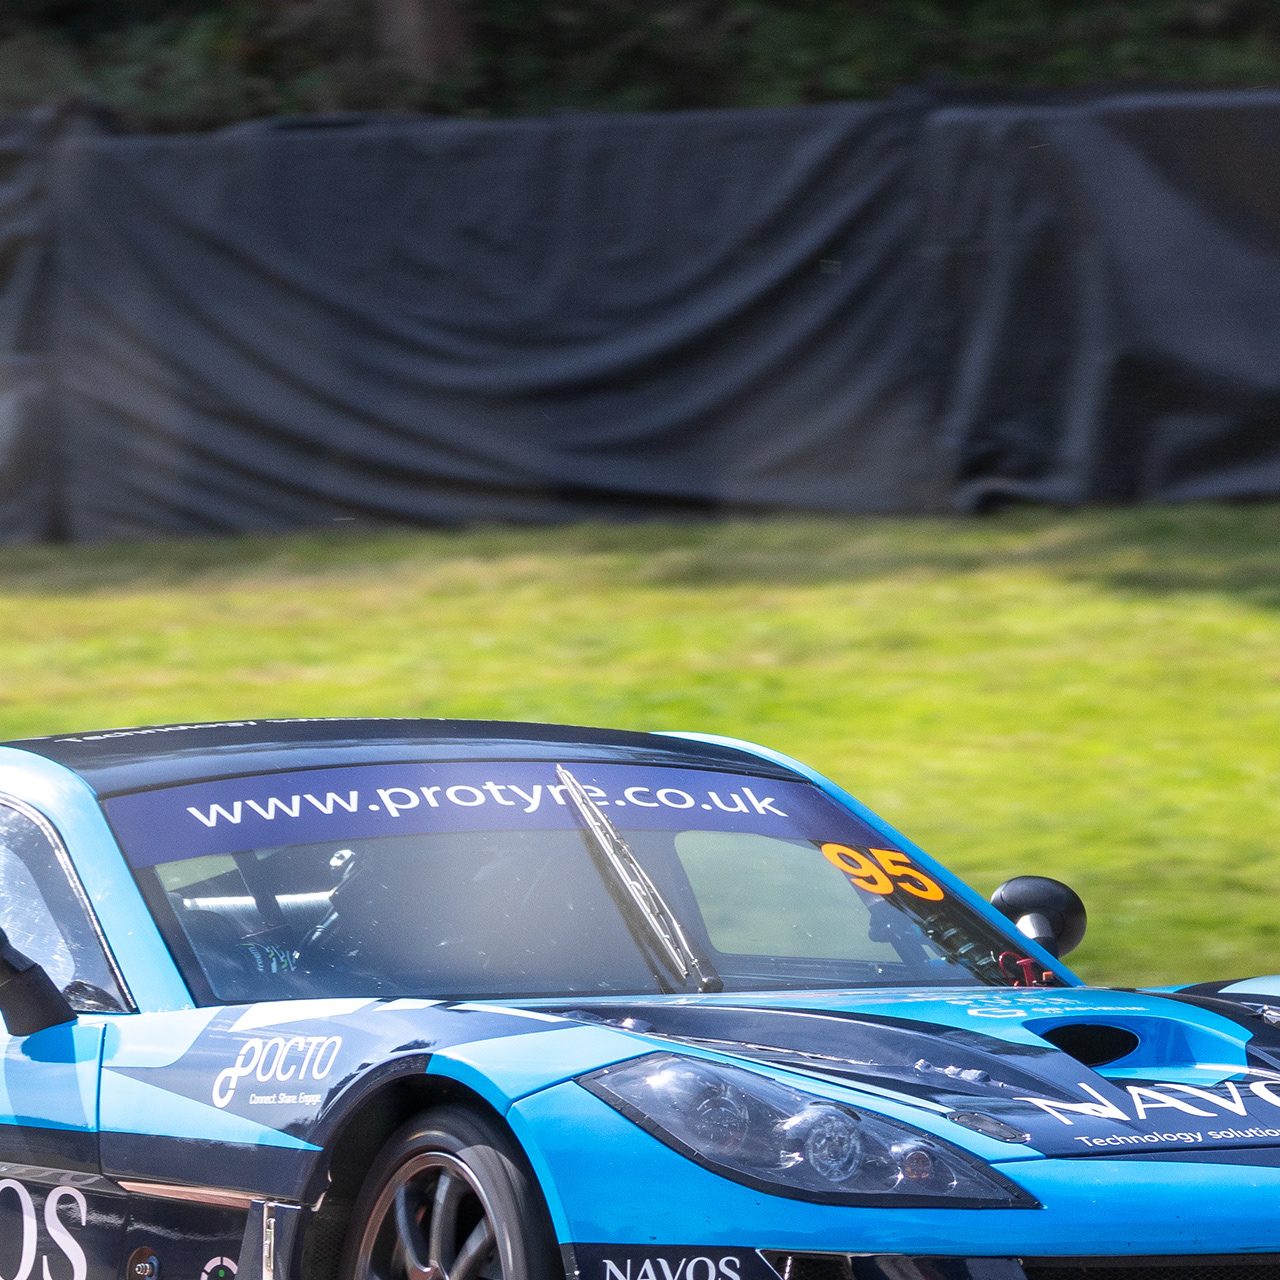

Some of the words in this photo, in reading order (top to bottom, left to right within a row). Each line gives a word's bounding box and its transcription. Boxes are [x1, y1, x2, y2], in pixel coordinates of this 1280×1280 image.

[186, 775, 789, 828] www.protyre.co.uk
[820, 842, 945, 902] 95
[1074, 1130, 1203, 1148] Technology
